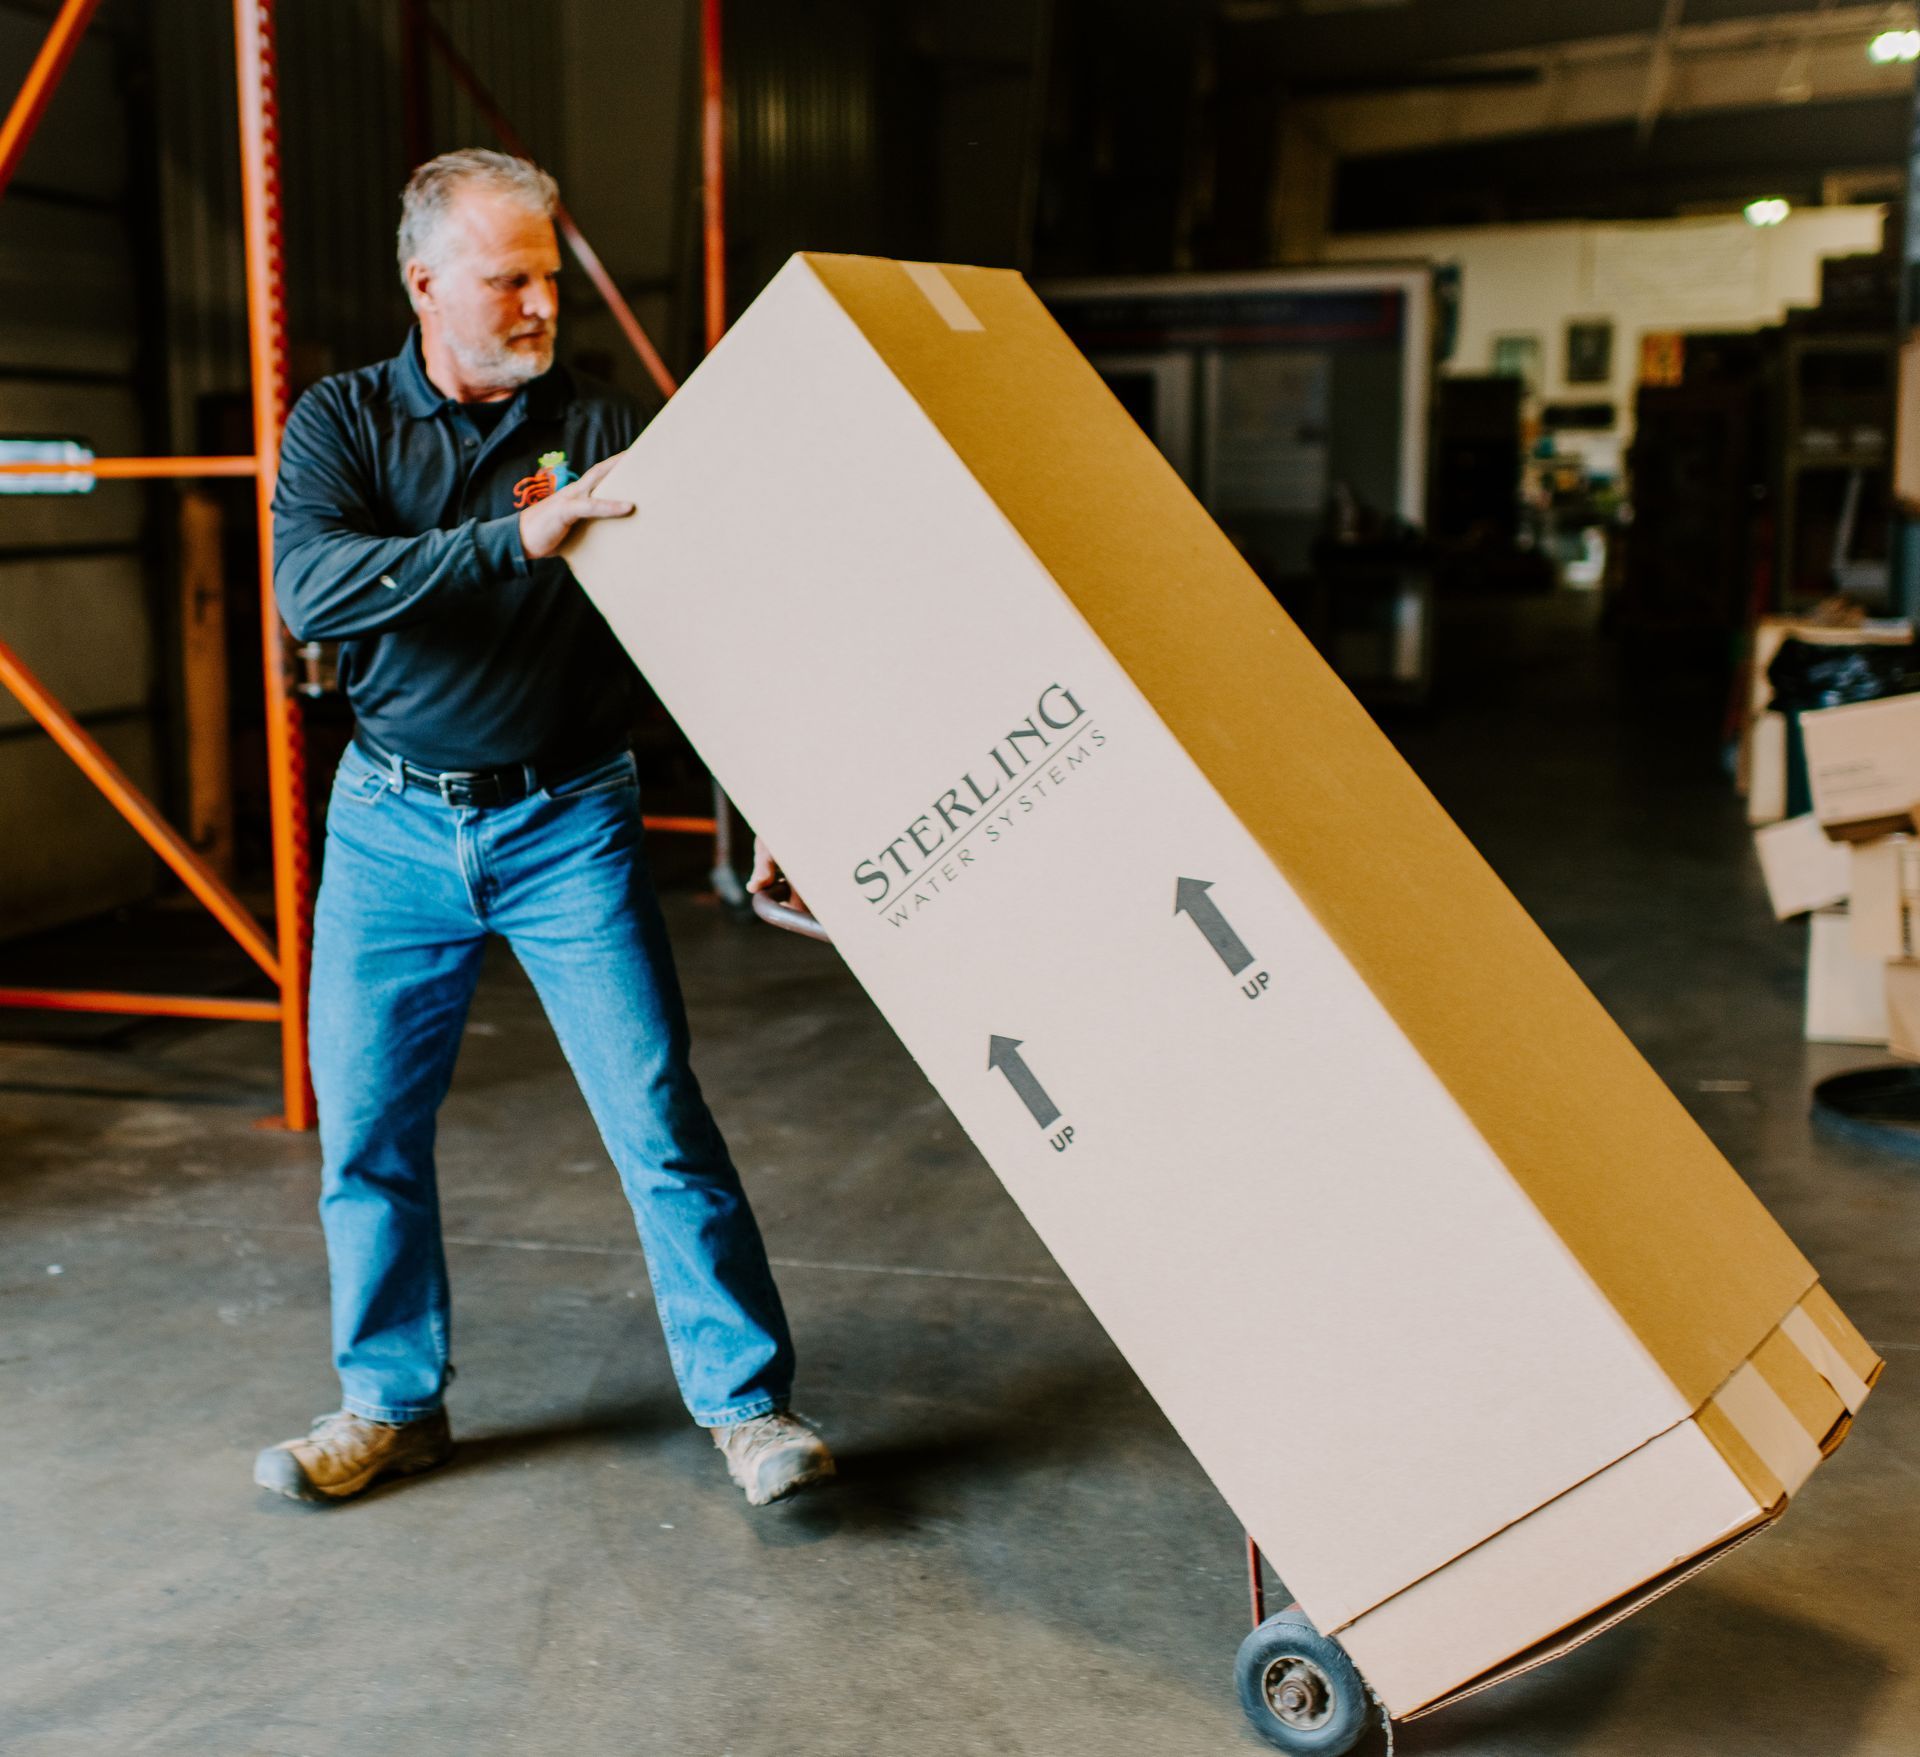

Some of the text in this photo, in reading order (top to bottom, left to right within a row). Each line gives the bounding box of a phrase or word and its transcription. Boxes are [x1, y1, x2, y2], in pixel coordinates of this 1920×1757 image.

[853, 683, 1086, 904] STERLING
[887, 728, 1107, 928] WATER SYSTEMS
[1241, 971, 1271, 1000] UP
[1049, 1125, 1076, 1153] UP
